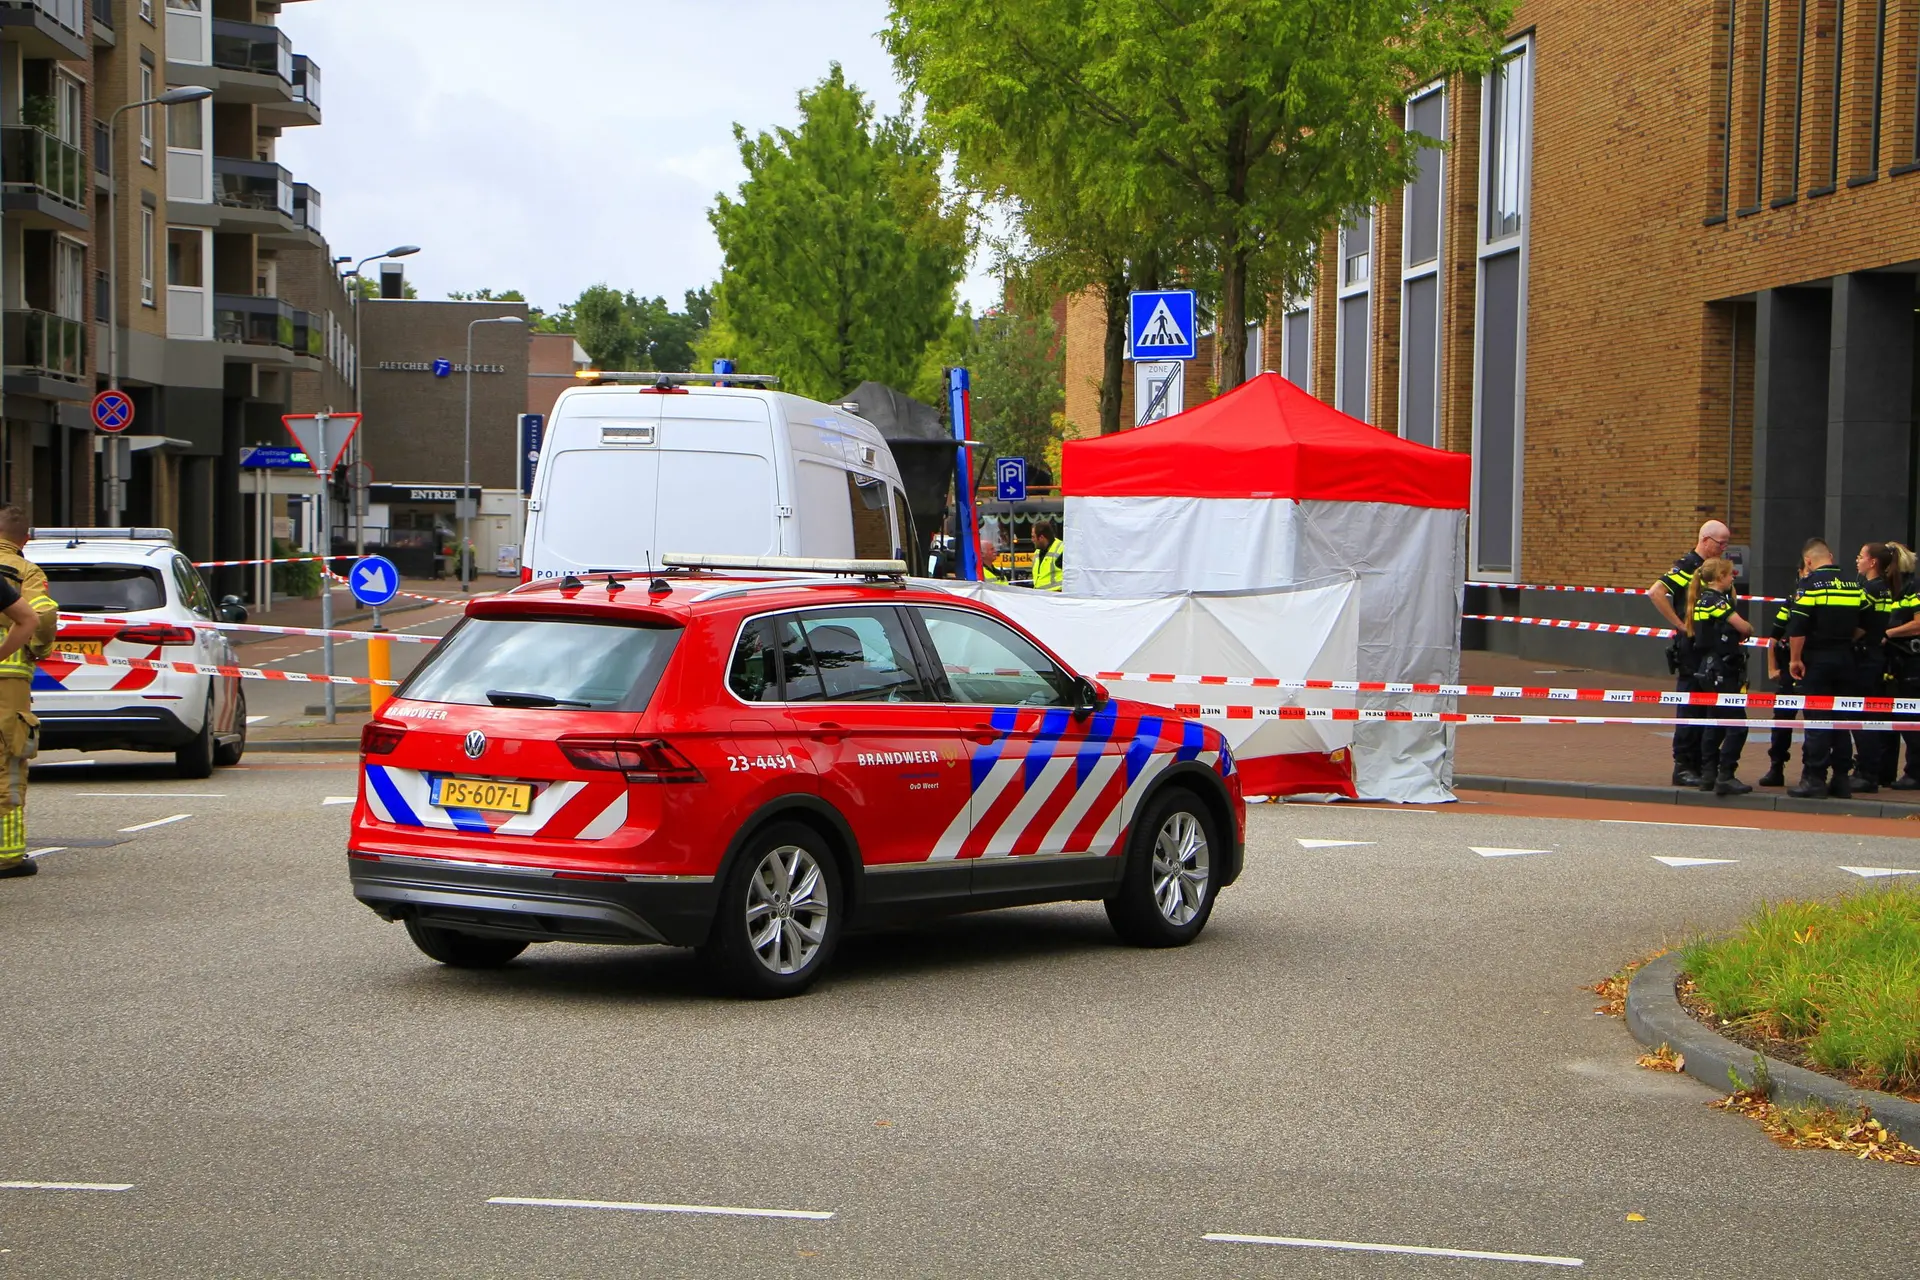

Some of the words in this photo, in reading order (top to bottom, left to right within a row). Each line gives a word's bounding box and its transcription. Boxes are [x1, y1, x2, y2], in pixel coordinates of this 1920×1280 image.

[379, 361, 430, 371] FLETCHER
[454, 363, 505, 373] HOTELS
[1148, 365, 1168, 373] ZONE
[410, 489, 457, 500] ENTREE
[1724, 697, 1746, 705] NIET
[1748, 698, 1798, 706] BETREDEN
[1841, 700, 1863, 708] NIET
[1866, 701, 1917, 710] BETREDEN
[384, 706, 448, 721] BRANDWEER
[1306, 708, 1326, 716] NIET
[727, 753, 798, 772] 23-4491
[857, 750, 939, 766] BRANDWEER
[922, 782, 939, 790] Weert
[432, 792, 439, 800] NL
[445, 782, 522, 808] PS-607-L
